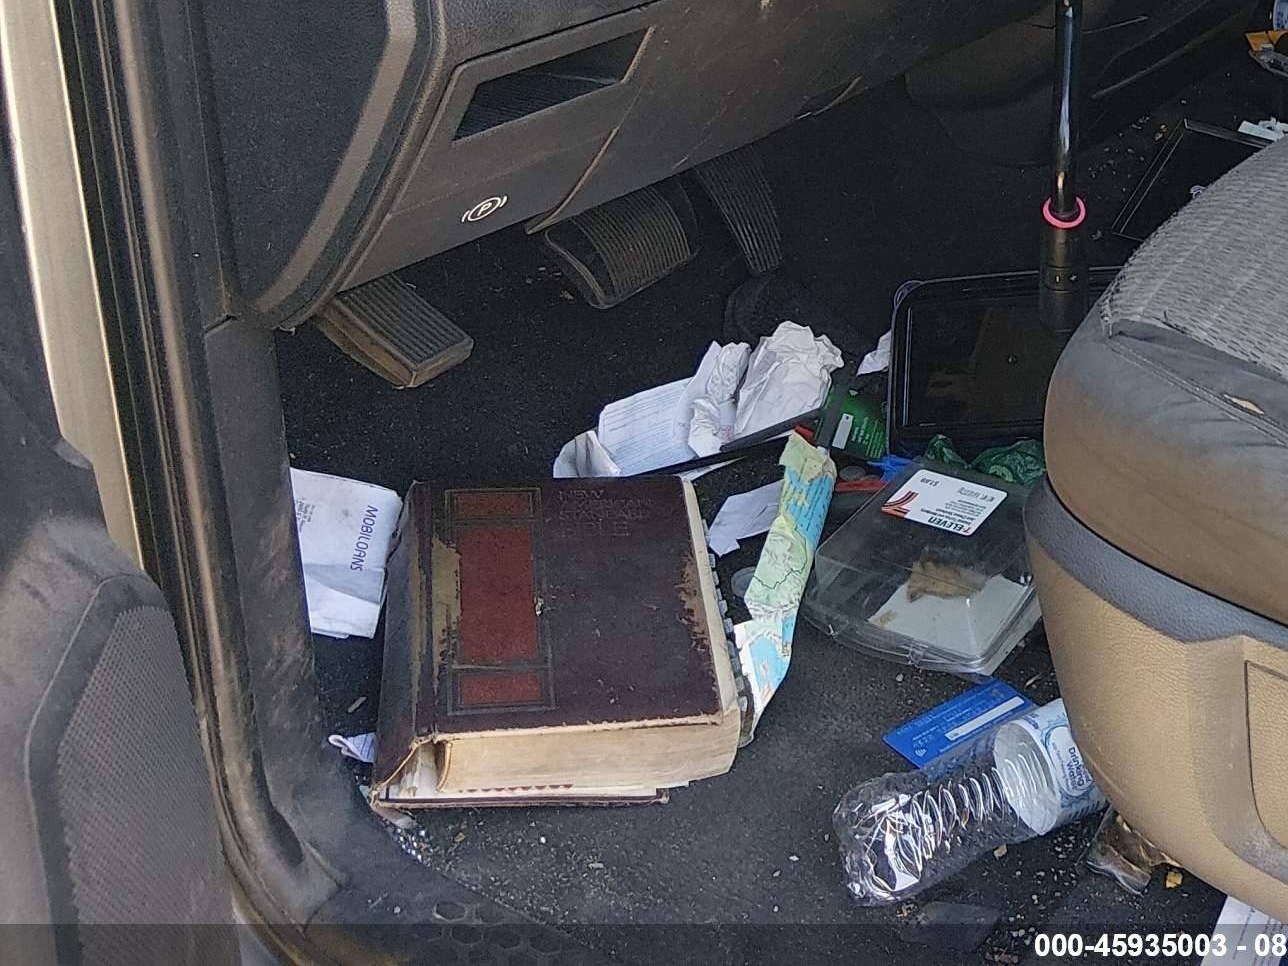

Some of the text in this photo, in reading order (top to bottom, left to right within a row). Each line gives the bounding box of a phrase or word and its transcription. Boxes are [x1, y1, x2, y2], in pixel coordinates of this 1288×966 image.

[558, 490, 604, 500] NEW
[350, 505, 379, 572] MOBILOANS
[1068, 748, 1084, 786] Drinking
[1068, 760, 1078, 790] Water
